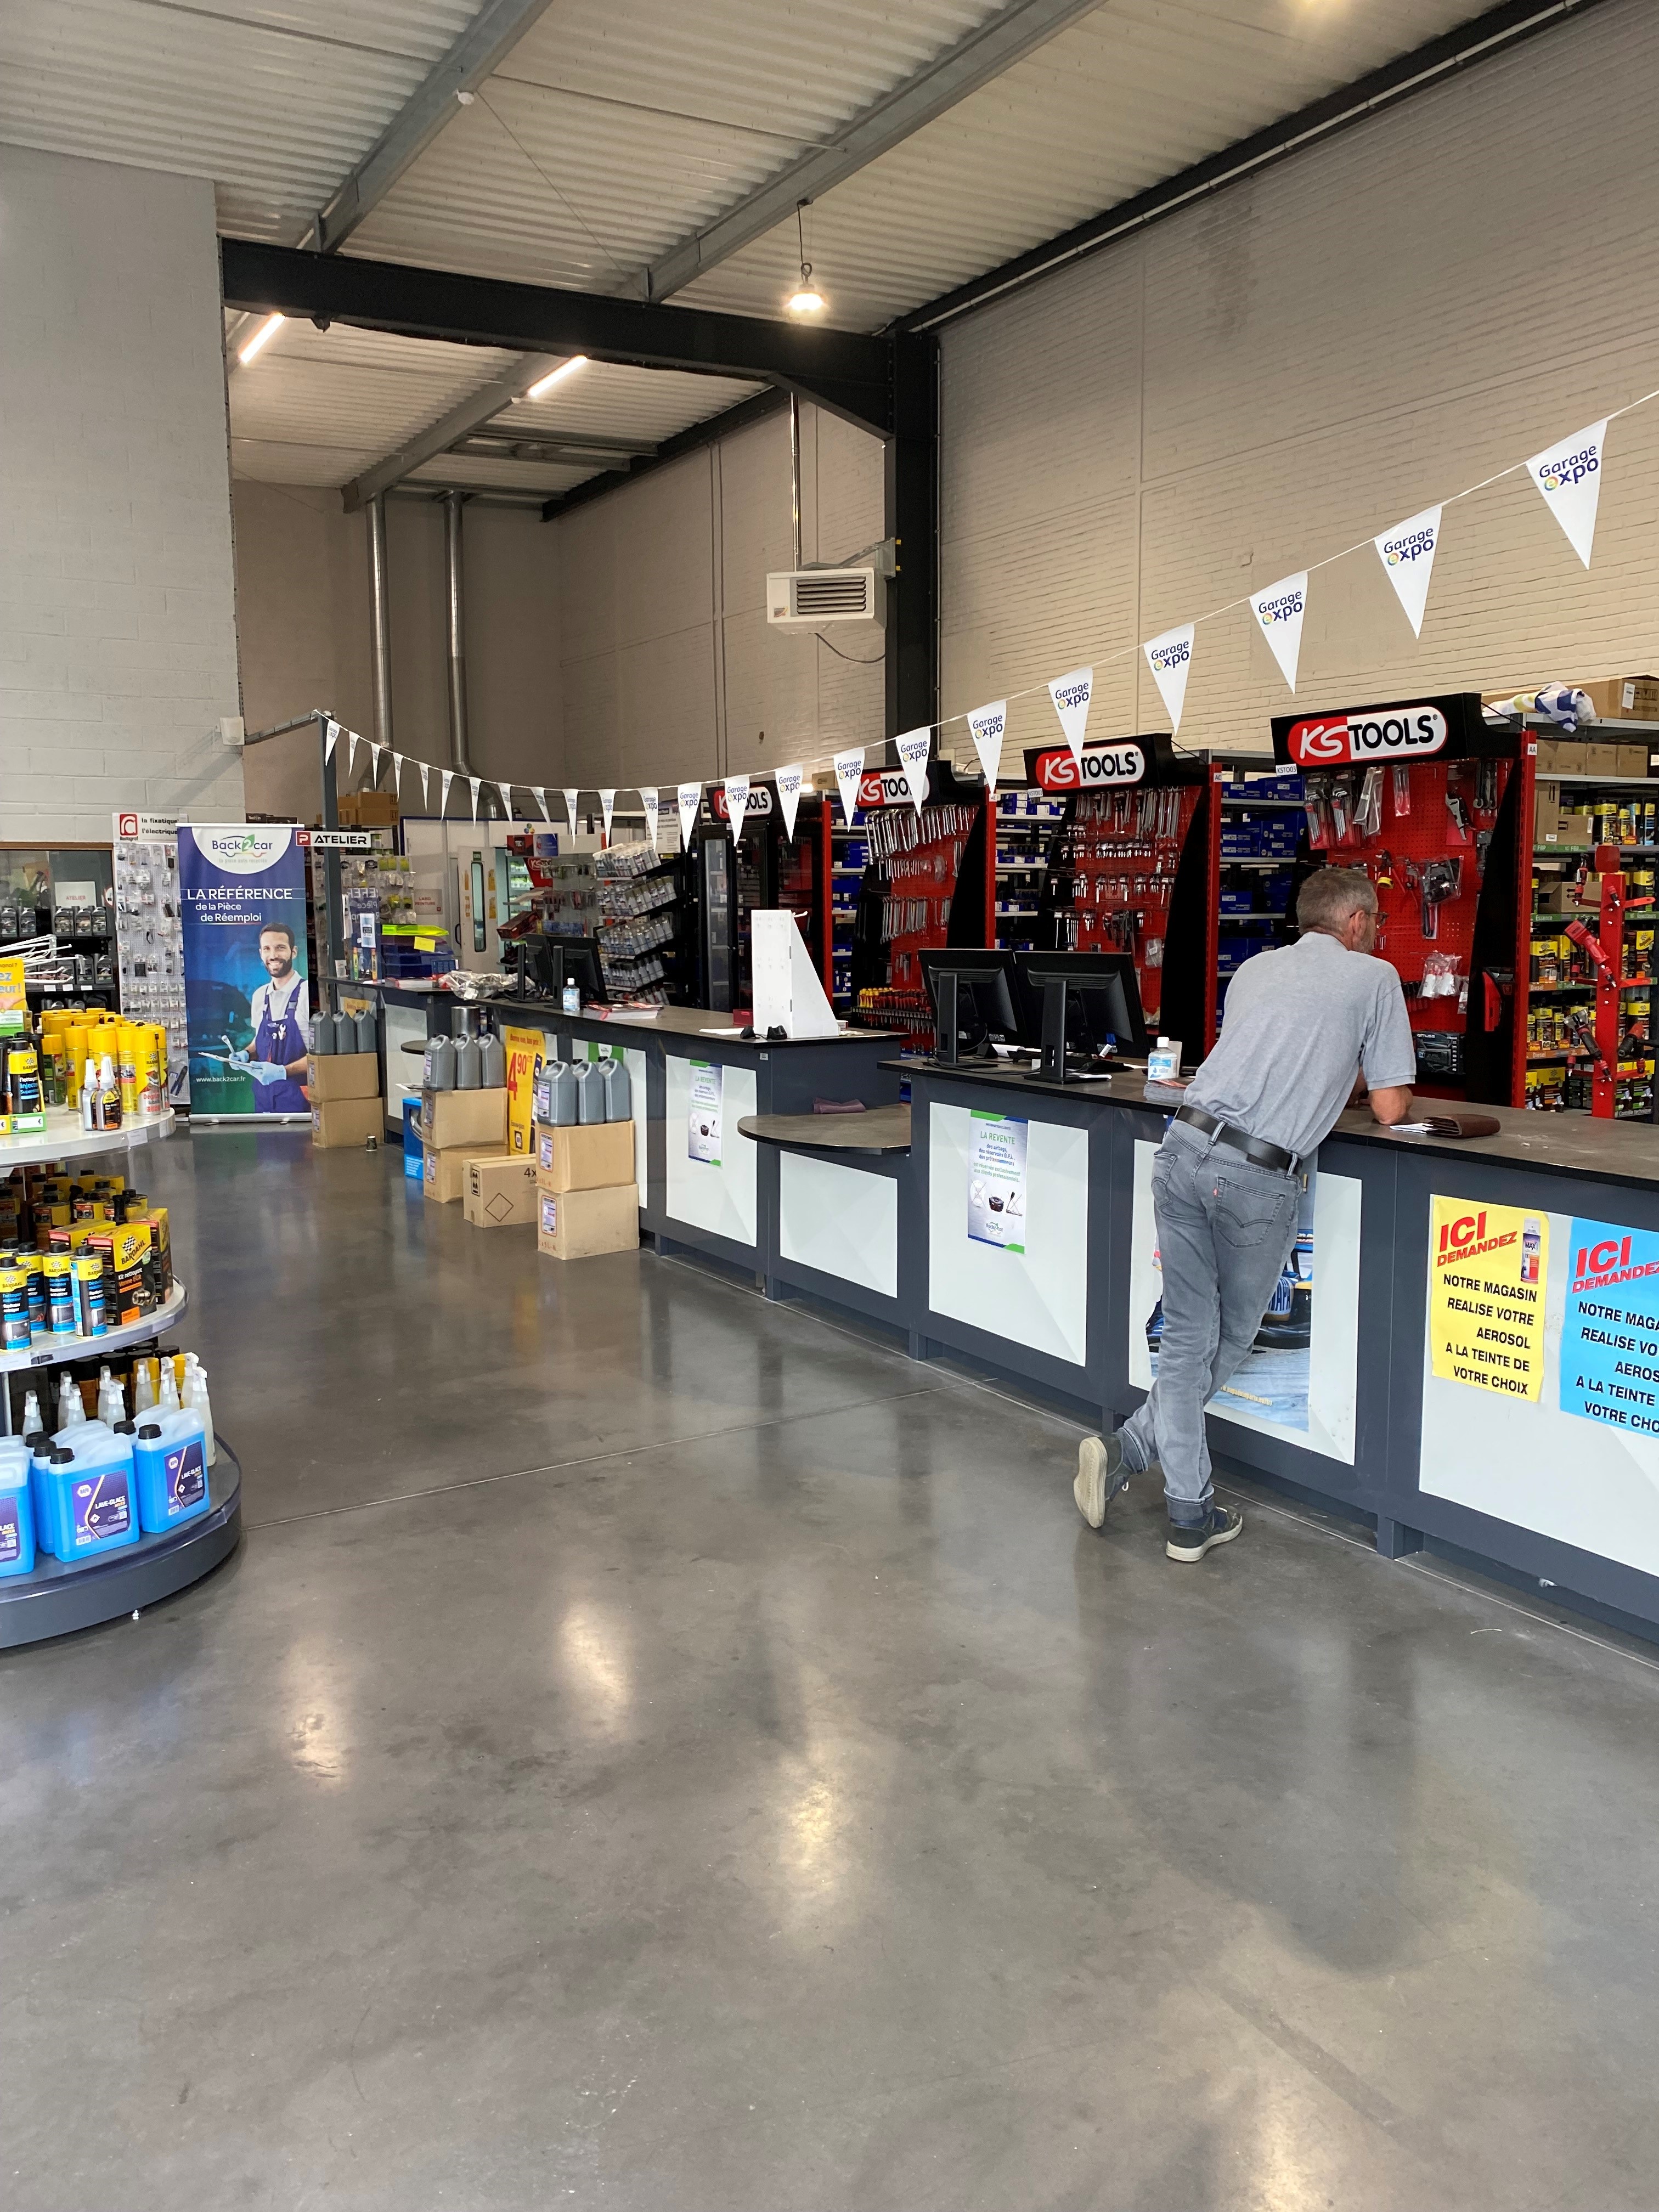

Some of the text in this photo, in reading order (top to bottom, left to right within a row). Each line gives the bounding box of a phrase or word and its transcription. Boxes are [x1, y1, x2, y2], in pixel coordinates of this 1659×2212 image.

[1539, 445, 1597, 478] Garage
[1544, 457, 1599, 491] expo
[1384, 526, 1434, 554] Garage
[1387, 539, 1434, 566] expo
[1259, 590, 1302, 614] Garage
[1262, 600, 1303, 625] expo
[1151, 641, 1189, 660] Garage
[1154, 650, 1189, 671] expo
[1056, 682, 1089, 699] Garage
[1058, 691, 1089, 710] expo
[973, 714, 1003, 730] Garage
[975, 723, 1003, 738] expo
[901, 739, 927, 753] Garage
[1300, 715, 1434, 759] KS TOOLS
[838, 760, 861, 772] Garage
[1045, 752, 1137, 784] KS TOOLS
[779, 775, 800, 783] Garage
[881, 777, 911, 798] TOO
[680, 792, 698, 800] Garage
[212, 838, 273, 850] Back2car
[314, 835, 367, 844] ATELIER
[188, 885, 293, 900] LA RÉFÉRENCE
[201, 912, 262, 923] de Réemploi
[218, 902, 241, 911] Pièce
[989, 1133, 1015, 1144] REVENTE
[1439, 1211, 1487, 1252] ICI
[121, 1239, 146, 1265] BARDAHL
[1437, 1231, 1518, 1267] DEMANDEZ
[1575, 1235, 1632, 1279] ICI
[1443, 1273, 1538, 1303] NOTRE MAGASIN
[1447, 1297, 1534, 1326] REALISE VOTRE
[1578, 1301, 1622, 1323] NOTRE
[1476, 1327, 1531, 1350] AEROSOL
[1581, 1326, 1659, 1356] REALISE VO
[1446, 1342, 1530, 1373] A LA TEINTE DE
[1453, 1365, 1528, 1395] VOTRE CHOIX
[1615, 1361, 1659, 1383] AEROS
[1576, 1375, 1655, 1407] A LA TEINTE
[1584, 1401, 1659, 1433] VOTRE CHO
[95, 1496, 126, 1509] LAVE-GLACE
